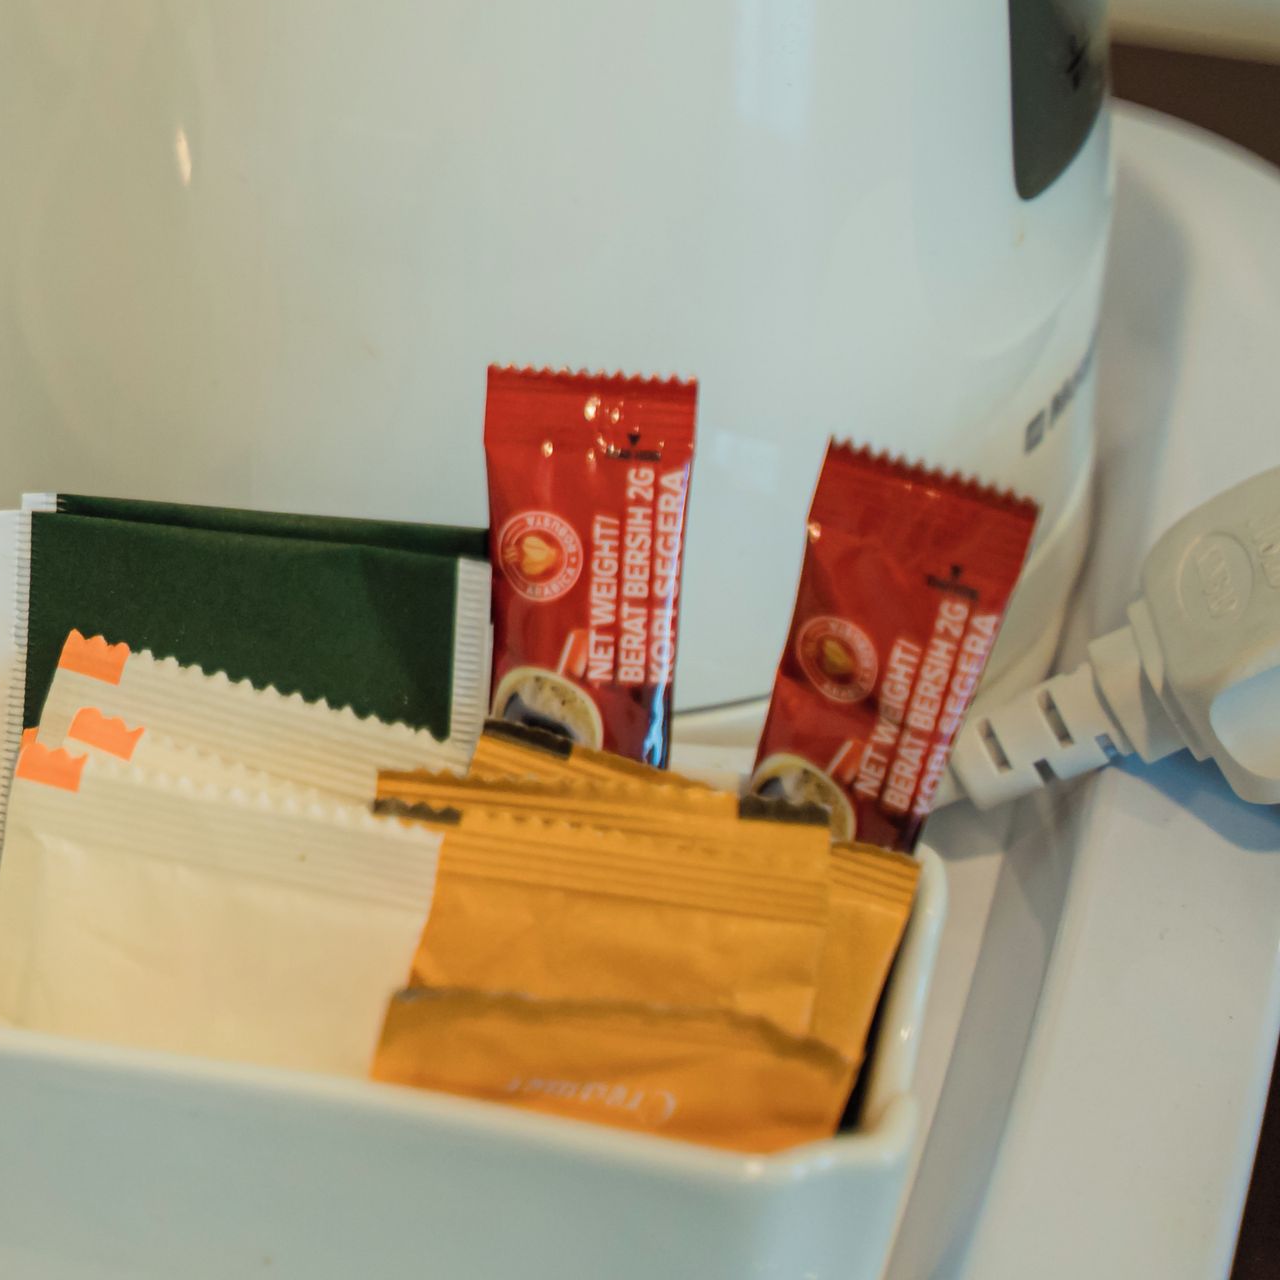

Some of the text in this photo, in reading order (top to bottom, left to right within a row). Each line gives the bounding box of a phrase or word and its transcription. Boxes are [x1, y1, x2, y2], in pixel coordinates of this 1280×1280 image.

[626, 467, 656, 502] 2G
[587, 514, 620, 682] NET WEIGHT/
[621, 507, 653, 599] BERSIH
[648, 469, 685, 685] KOPI SEGERA
[617, 602, 647, 684] BERAT
[883, 729, 929, 812] BERAT
[906, 639, 956, 729] BERSIH
[935, 599, 969, 638] 2G
[855, 744, 889, 799] NET
